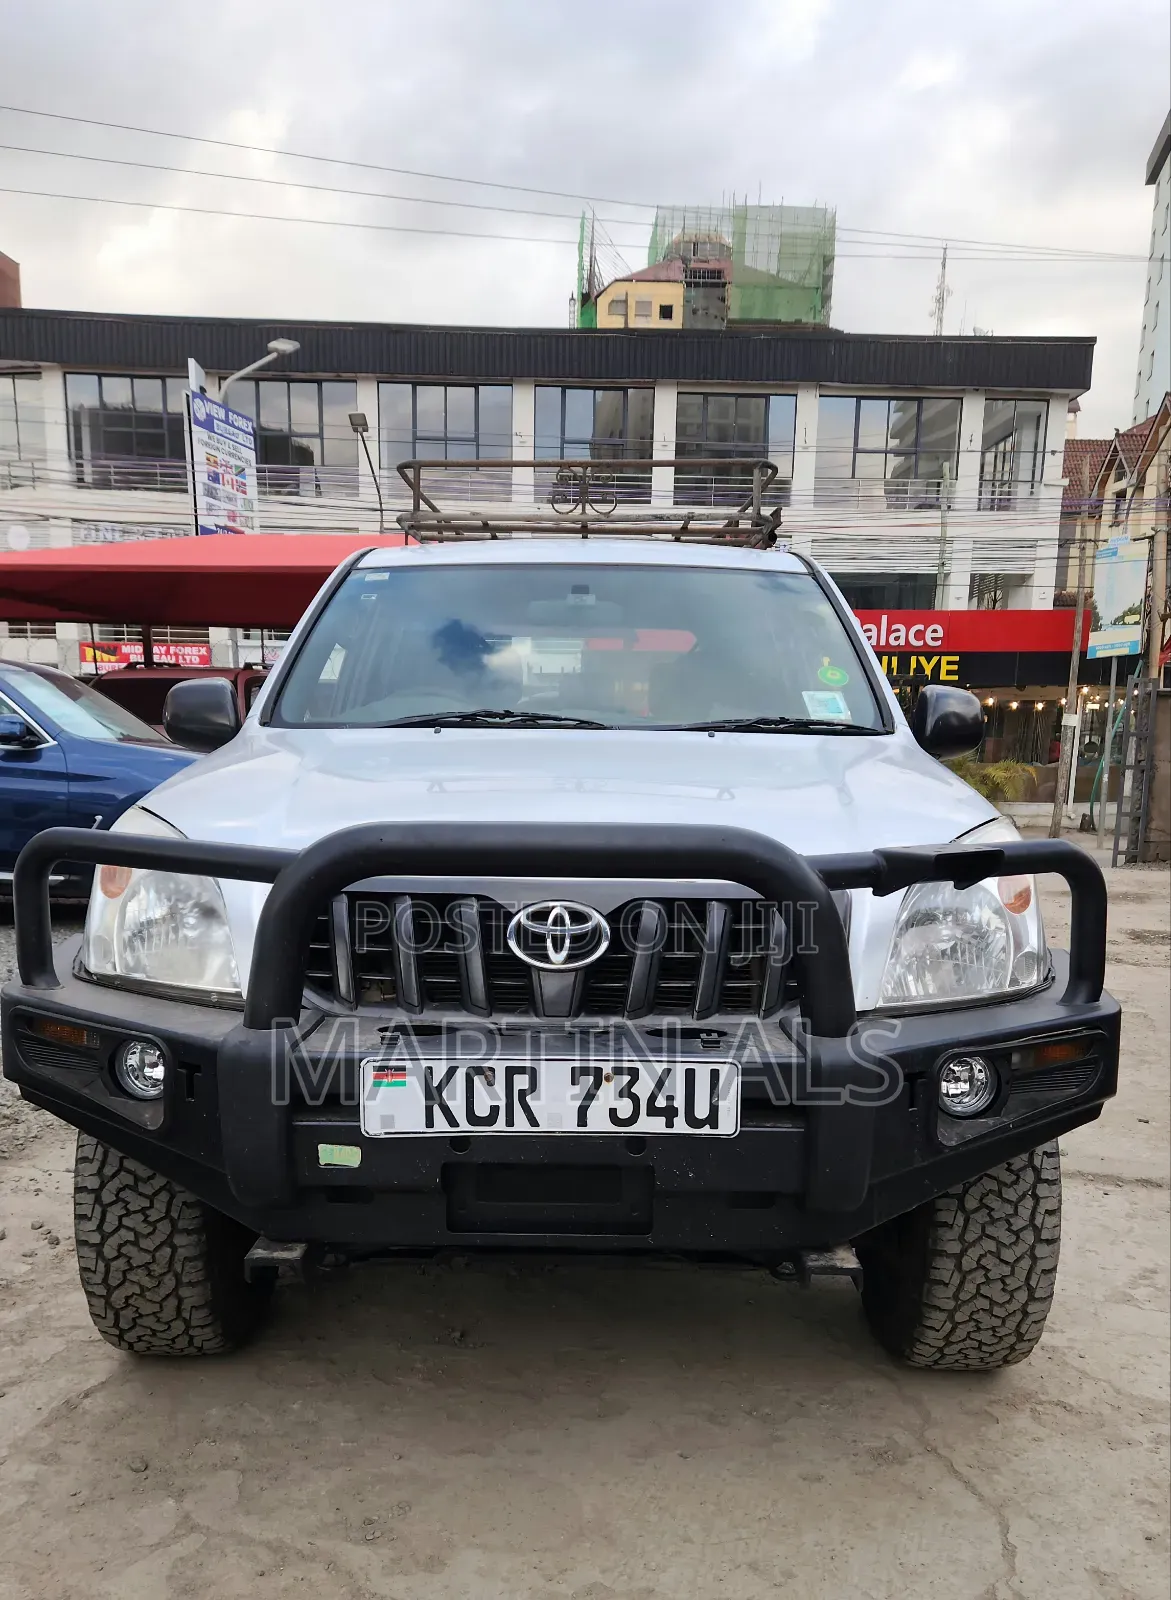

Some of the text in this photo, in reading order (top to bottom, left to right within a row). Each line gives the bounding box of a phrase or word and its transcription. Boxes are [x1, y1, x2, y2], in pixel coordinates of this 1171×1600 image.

[204, 399, 254, 434] VIEW FOREX
[197, 437, 221, 453] FOREIGN
[855, 614, 944, 647] alace
[121, 645, 167, 655] MIDAY
[169, 646, 208, 656] FOREX
[129, 654, 200, 664] BUEAU LTD
[424, 1065, 541, 1129] KCR
[570, 1066, 720, 1130] 734U
